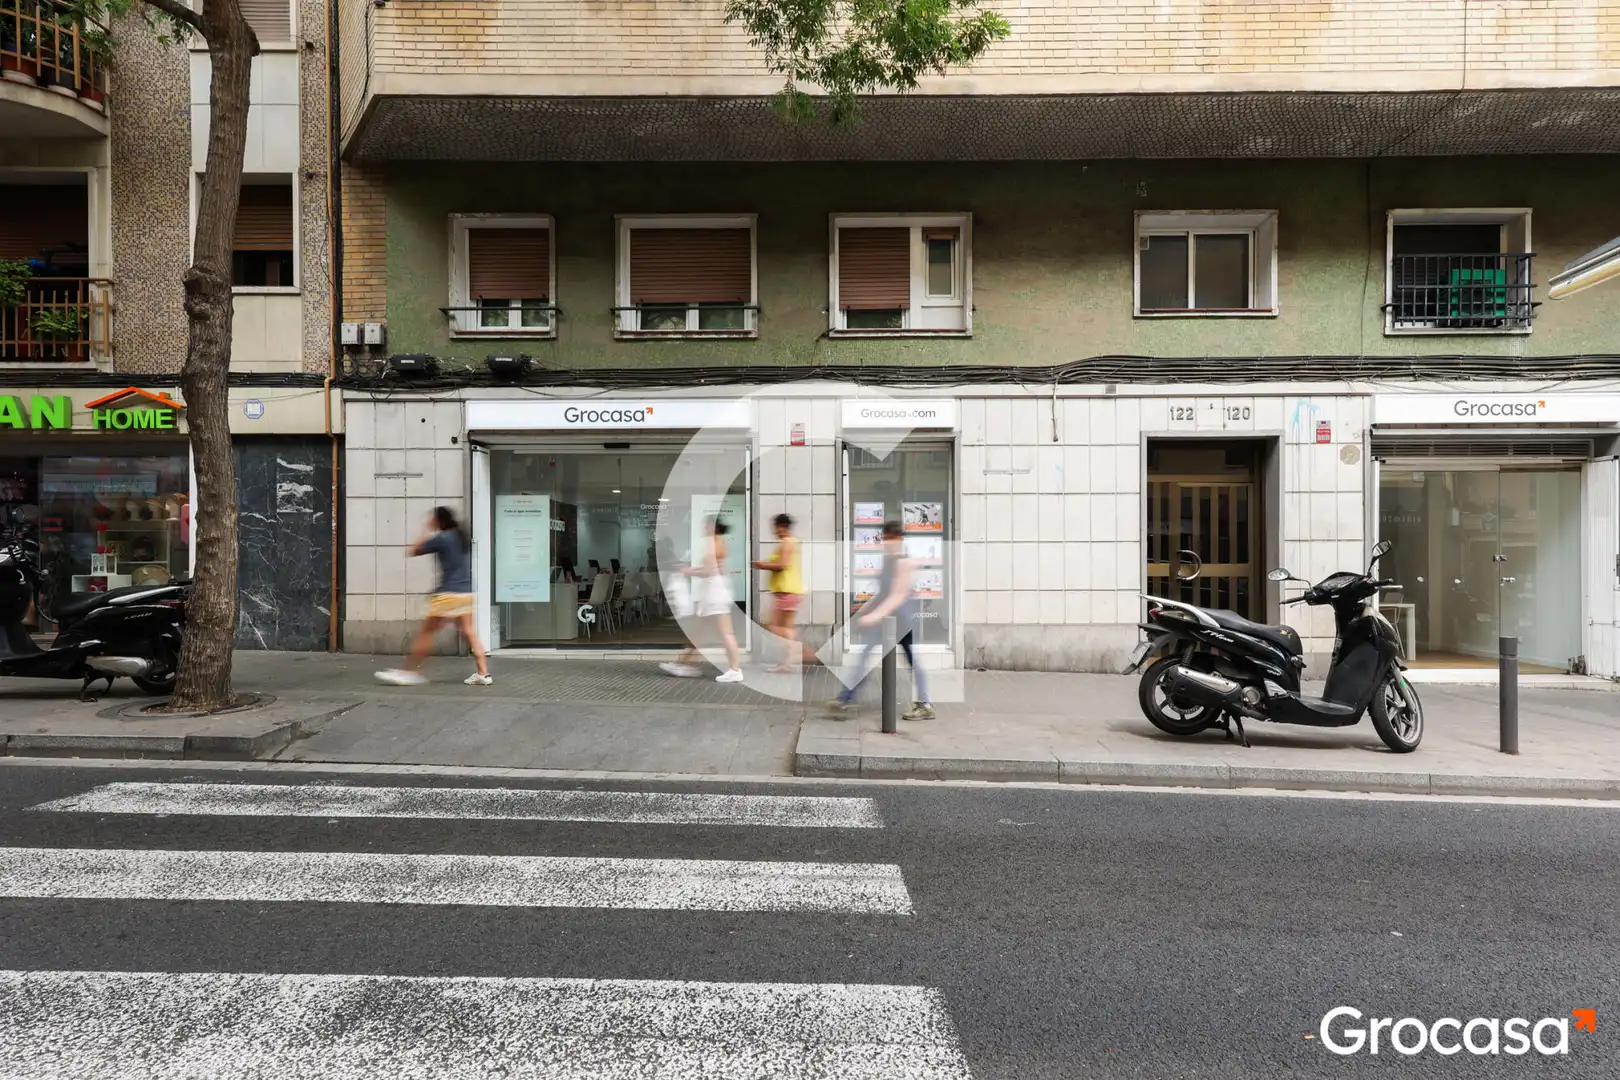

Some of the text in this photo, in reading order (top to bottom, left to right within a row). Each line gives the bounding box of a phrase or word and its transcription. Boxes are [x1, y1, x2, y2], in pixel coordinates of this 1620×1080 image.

[564, 407, 645, 423] Grocasa
[1169, 406, 1194, 421] 122
[1226, 406, 1251, 421] 120
[1454, 400, 1537, 416] Grocasa
[92, 408, 174, 429] HOME
[577, 604, 596, 624] G
